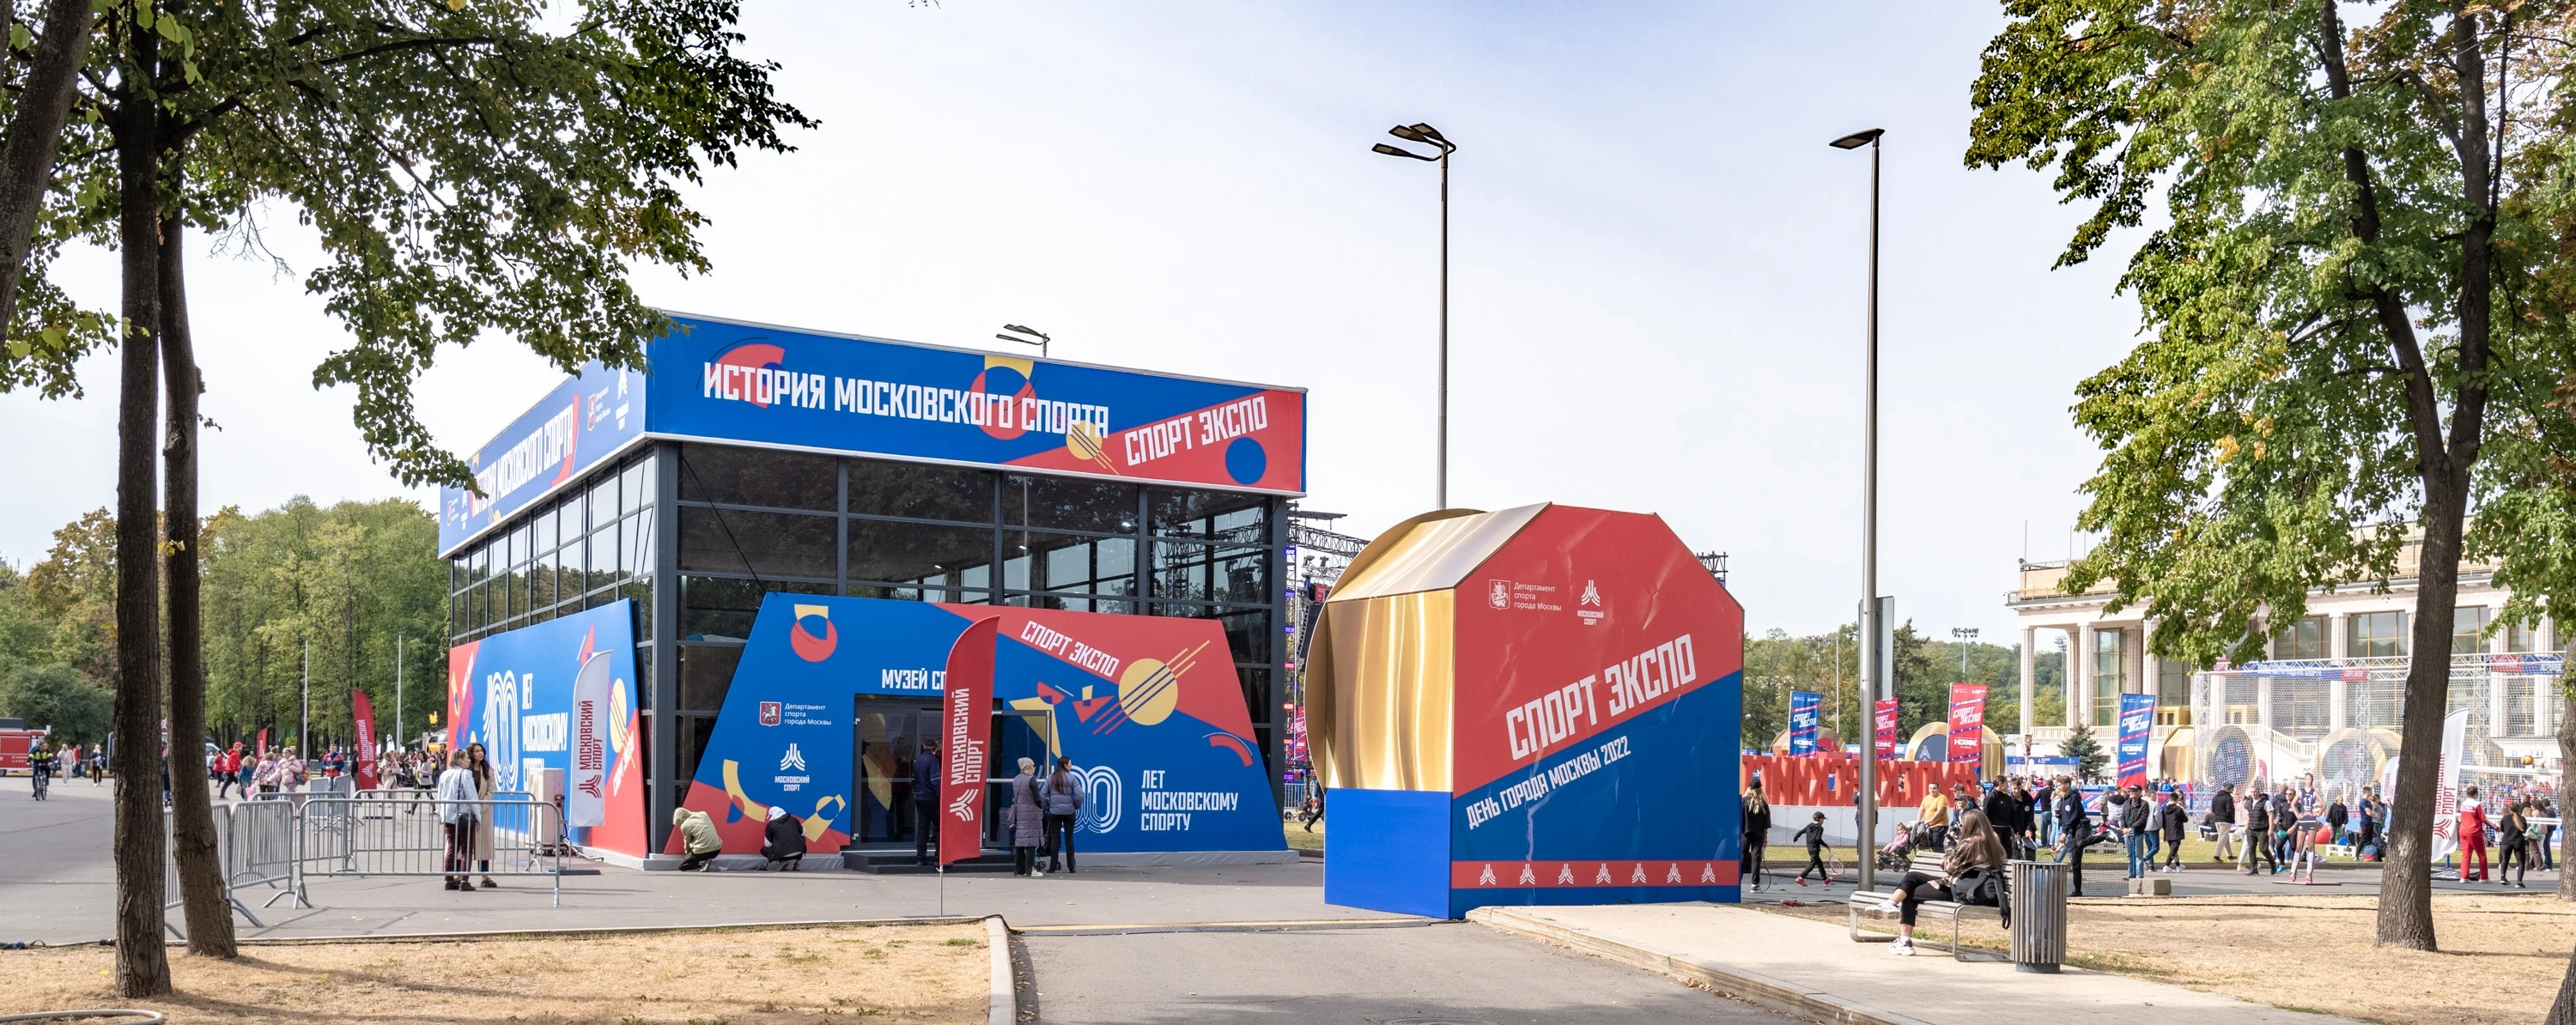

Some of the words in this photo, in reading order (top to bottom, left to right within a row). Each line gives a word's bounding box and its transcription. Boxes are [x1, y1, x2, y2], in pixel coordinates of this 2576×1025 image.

[703, 361, 826, 410] ИСТОРИЯ
[834, 376, 1013, 429] МОСКОВСКОГО
[1021, 397, 1109, 440] СПОРТА
[544, 403, 574, 471] СПОРТА
[1124, 415, 1193, 466] СПОРТ
[1199, 396, 1267, 446] ЭКСПО
[1514, 582, 1556, 592] Департамент
[1514, 602, 1535, 610] города
[1537, 603, 1562, 611] Москвы
[1020, 620, 1073, 656] СПОРТ
[1068, 641, 1120, 677] ЭКСПО
[881, 667, 928, 690] МУЗЕЙ
[1506, 674, 1598, 761] СПОРТ
[1604, 634, 1697, 717] ЭКСПО
[1953, 707, 1975, 719] СПОРТ
[1793, 712, 1811, 722] СПОРТ
[1875, 714, 1889, 723] ПОРТ
[357, 719, 369, 761] МОСКОВСКИЙ
[578, 701, 593, 770] МОСКОВСКИЙ
[951, 688, 969, 785] МОСКОВСКИЙ
[592, 737, 603, 770] СПОРТ
[964, 737, 984, 784] СПОРТ
[1141, 770, 1165, 789] ЛЕТ
[1466, 797, 1501, 830] ДЕНЬ
[1499, 773, 1549, 812] ГОРОДА
[1547, 749, 1601, 789] МОСКВЫ
[1601, 735, 1631, 766] 2022
[1141, 791, 1239, 811] МОСКОВСКОМУ
[2442, 785, 2456, 815] СПОРТ
[1140, 813, 1191, 831] СПОРТУ
